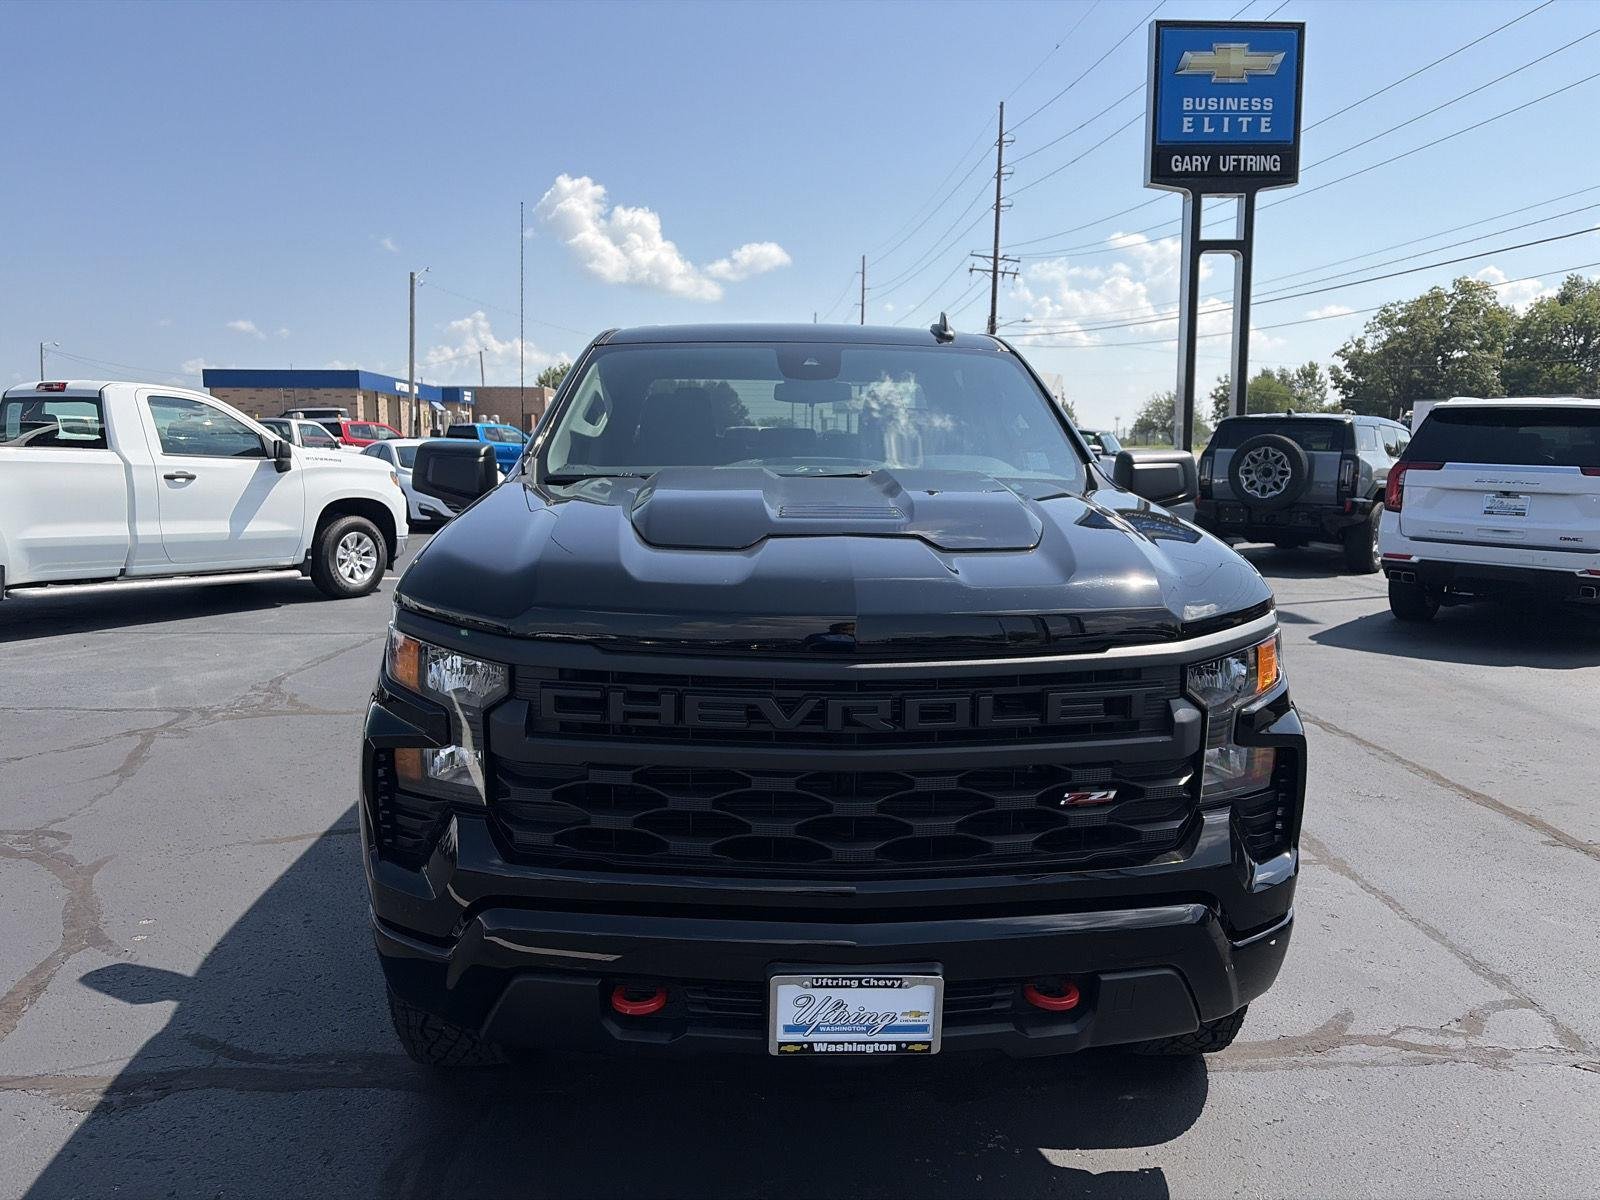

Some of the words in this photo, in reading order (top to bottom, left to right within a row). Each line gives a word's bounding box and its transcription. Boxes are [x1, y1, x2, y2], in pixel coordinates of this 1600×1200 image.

[1183, 97, 1273, 111] BUSINESS
[1182, 117, 1272, 133] ELITE
[1171, 155, 1211, 172] GARY
[1219, 155, 1281, 172] UFTRING
[540, 682, 1165, 732] CHEVROLET
[812, 978, 859, 988] Uftring
[861, 978, 902, 988] Chevy
[792, 994, 898, 1037] Uftring
[813, 1042, 897, 1053] Washington
